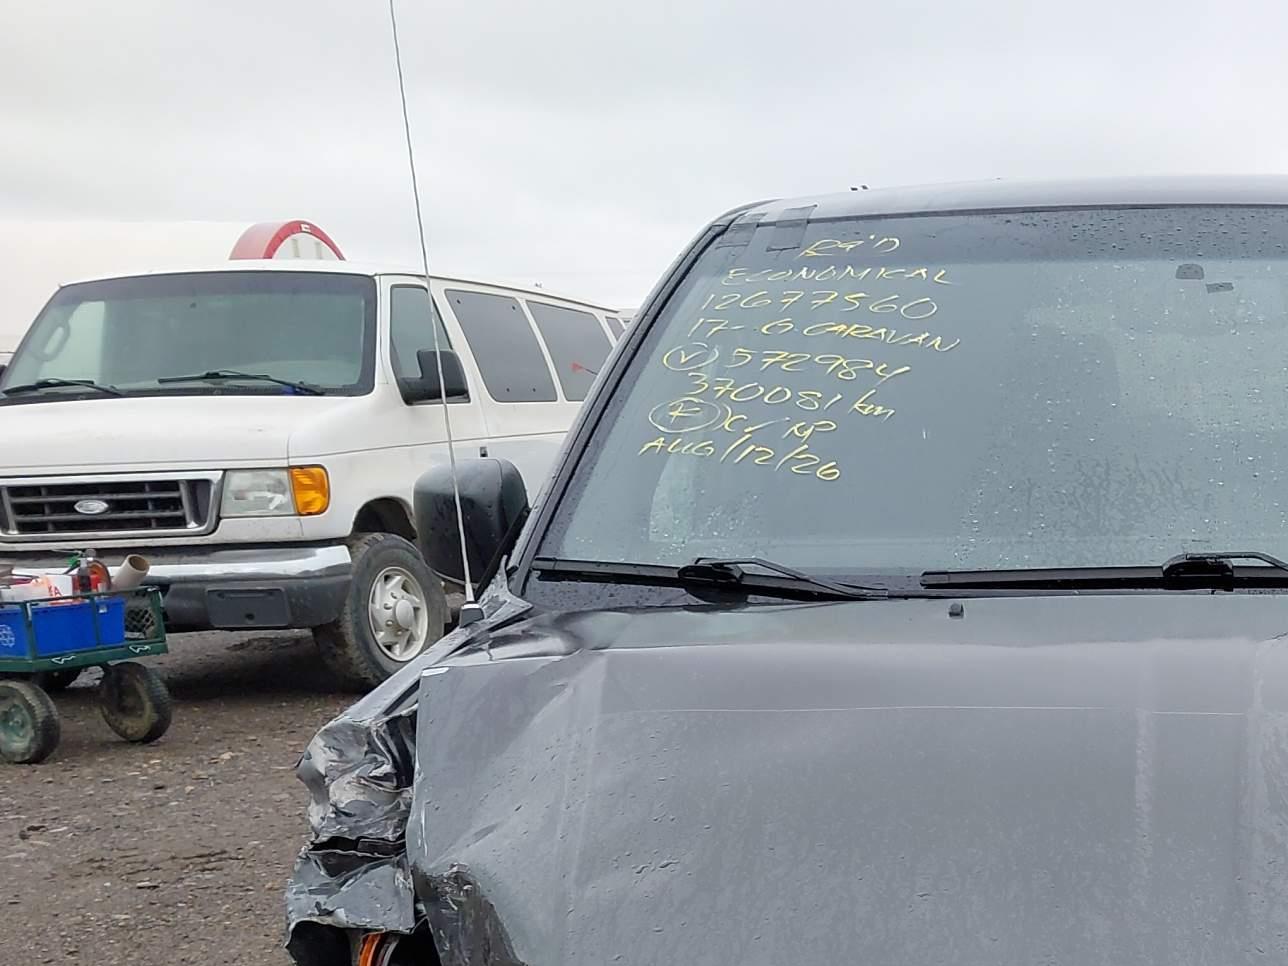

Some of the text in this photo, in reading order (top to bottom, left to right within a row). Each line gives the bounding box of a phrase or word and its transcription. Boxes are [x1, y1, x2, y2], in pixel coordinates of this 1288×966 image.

[701, 291, 938, 320] 12677560
[724, 347, 911, 387] 572984
[685, 372, 842, 410] 370081
